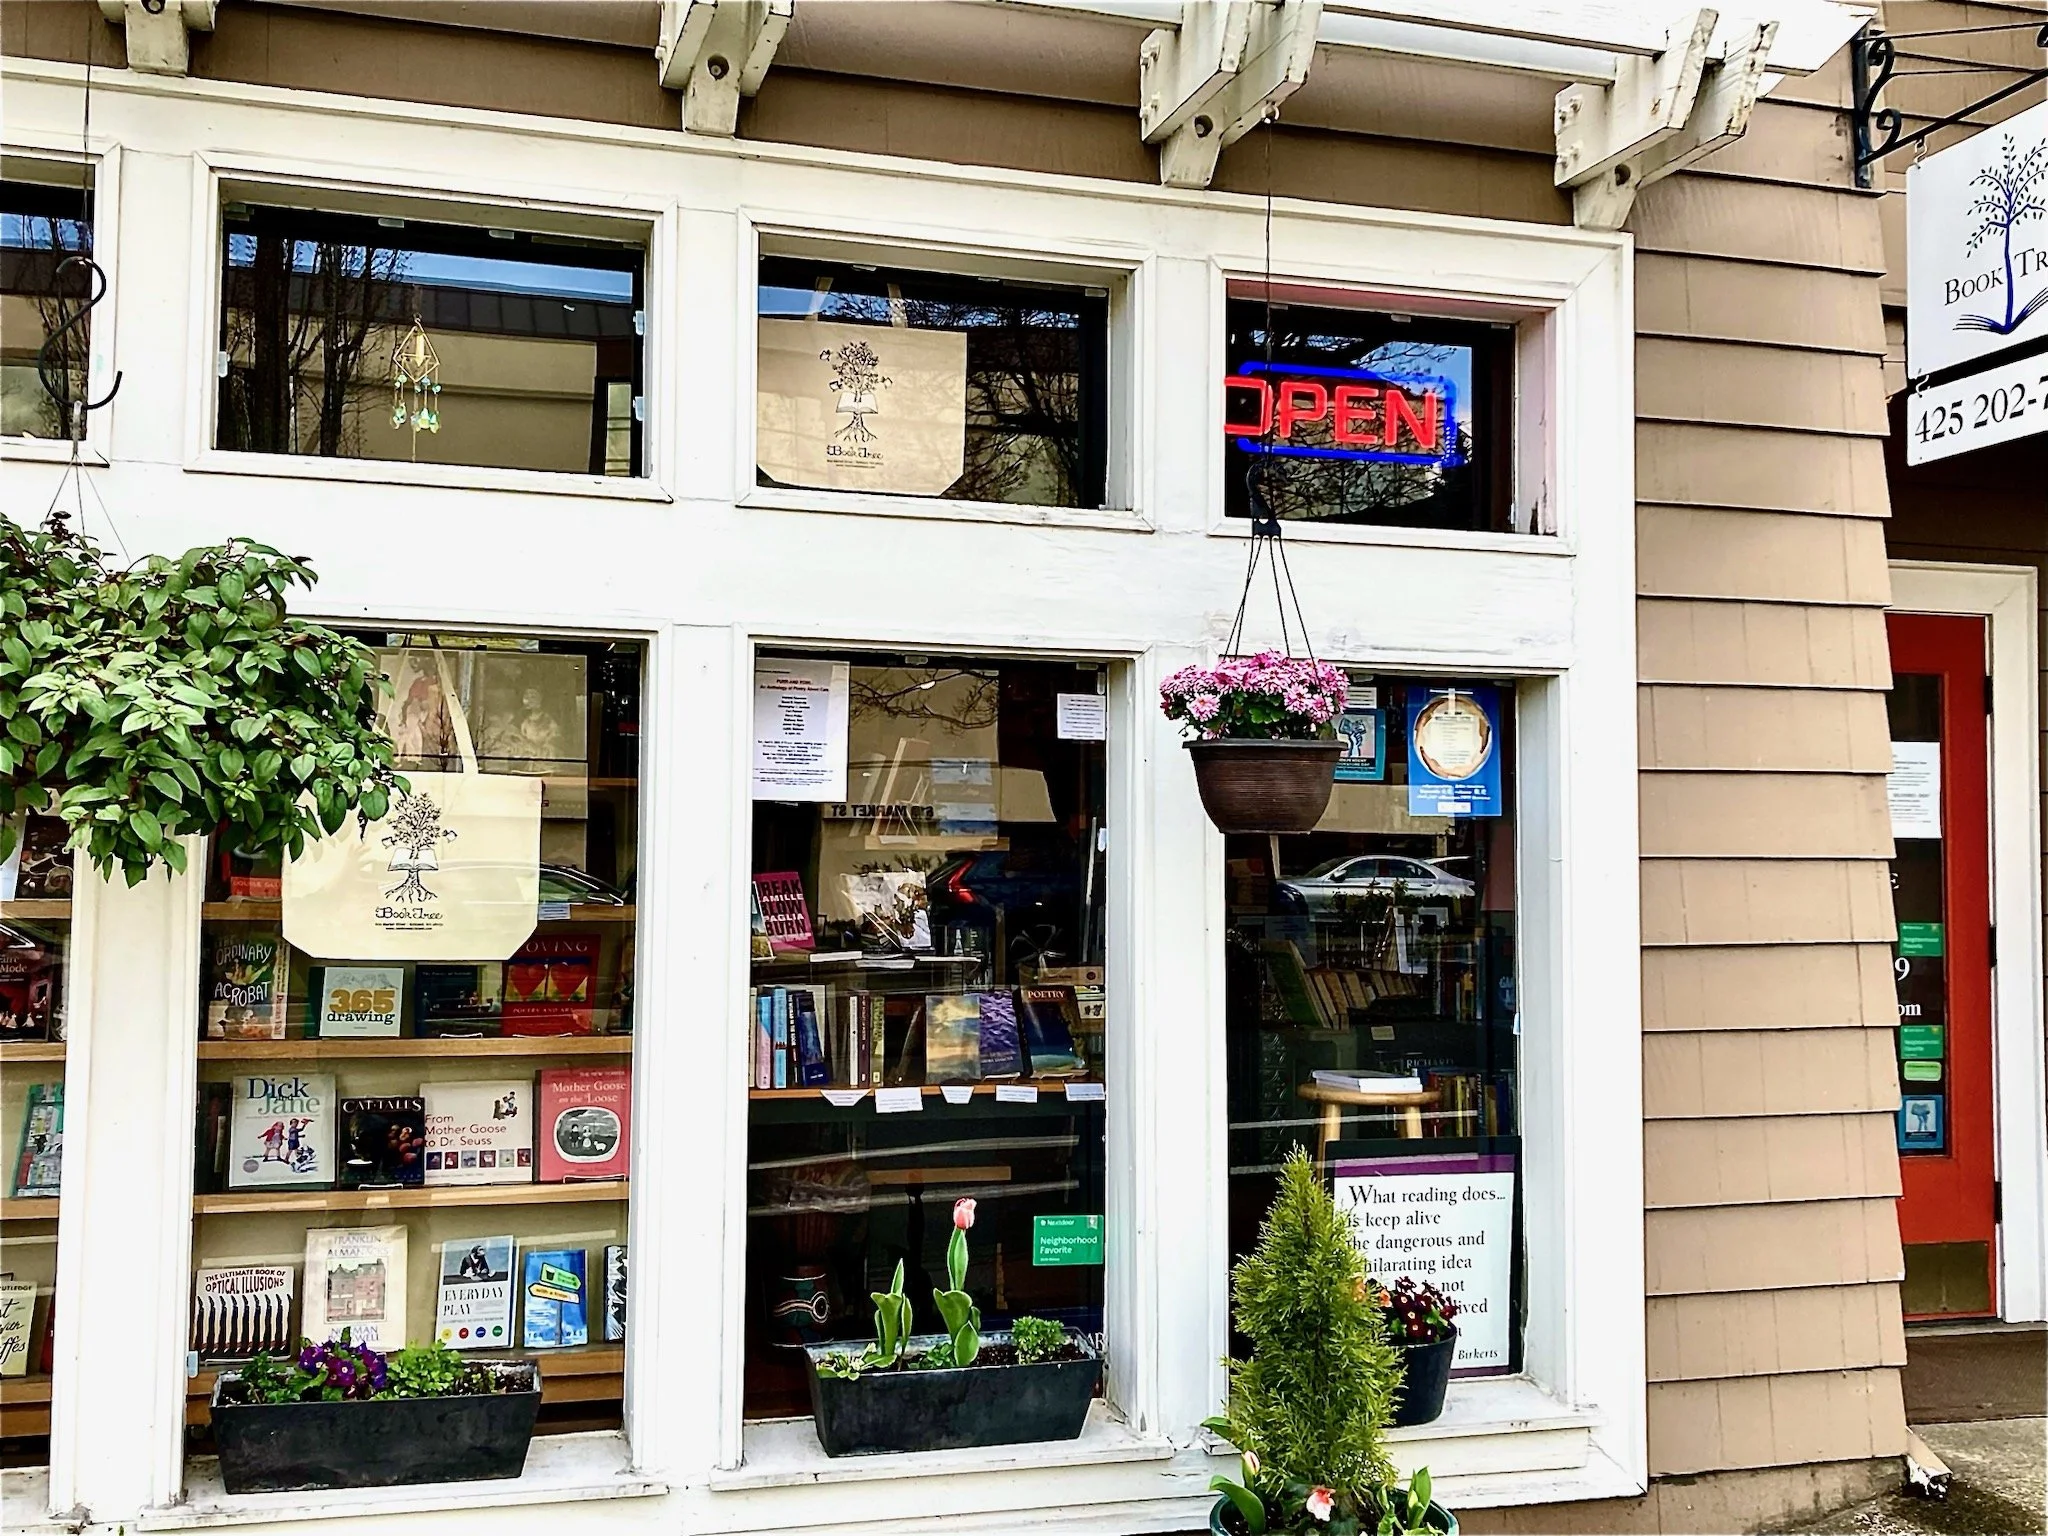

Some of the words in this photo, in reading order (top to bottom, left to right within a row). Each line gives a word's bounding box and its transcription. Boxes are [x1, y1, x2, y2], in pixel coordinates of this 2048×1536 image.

[1944, 267, 2004, 306] BOOK
[1224, 376, 1438, 449] OPEN
[1914, 400, 1963, 444] 425
[761, 893, 804, 903] AMILLE
[375, 906, 411, 919] Book
[412, 907, 443, 919] Tree
[525, 941, 588, 953] OVING
[215, 943, 273, 966] ORDINARY
[214, 980, 272, 1007] ACROBAT
[1028, 990, 1066, 998] POETRY
[328, 989, 396, 1014] 365
[327, 1011, 396, 1025] drawing
[247, 1076, 310, 1099] Dick
[552, 1081, 591, 1092] Mother
[593, 1080, 627, 1091] Goose
[258, 1093, 321, 1115] Jane
[586, 1092, 618, 1104] Loose
[425, 1114, 454, 1124] From
[424, 1125, 466, 1136] Mother
[469, 1123, 507, 1134] Goose
[424, 1139, 436, 1147] to
[440, 1136, 456, 1147] Dr.
[460, 1135, 492, 1146] Seuss
[1349, 1184, 1396, 1204] What
[1402, 1187, 1457, 1205] reading
[1366, 1212, 1400, 1230] keep
[1406, 1211, 1441, 1225] alive
[1040, 1236, 1098, 1246] Neighborhood
[1376, 1233, 1452, 1252] dangerous
[1458, 1231, 1485, 1246] and
[1040, 1246, 1073, 1255] Favorite
[1364, 1257, 1436, 1274] hilarating
[1442, 1254, 1472, 1269] idea
[205, 1273, 219, 1283] THE
[220, 1269, 254, 1279] ULTIMATE
[255, 1268, 276, 1276] BOOK
[205, 1277, 240, 1295] OPTICAL
[242, 1275, 284, 1294] ILLUSIONS
[1441, 1280, 1465, 1292] not
[444, 1286, 503, 1301] EVERYDAY
[443, 1303, 470, 1316] PLAY
[1458, 1348, 1498, 1360] Birkerts
